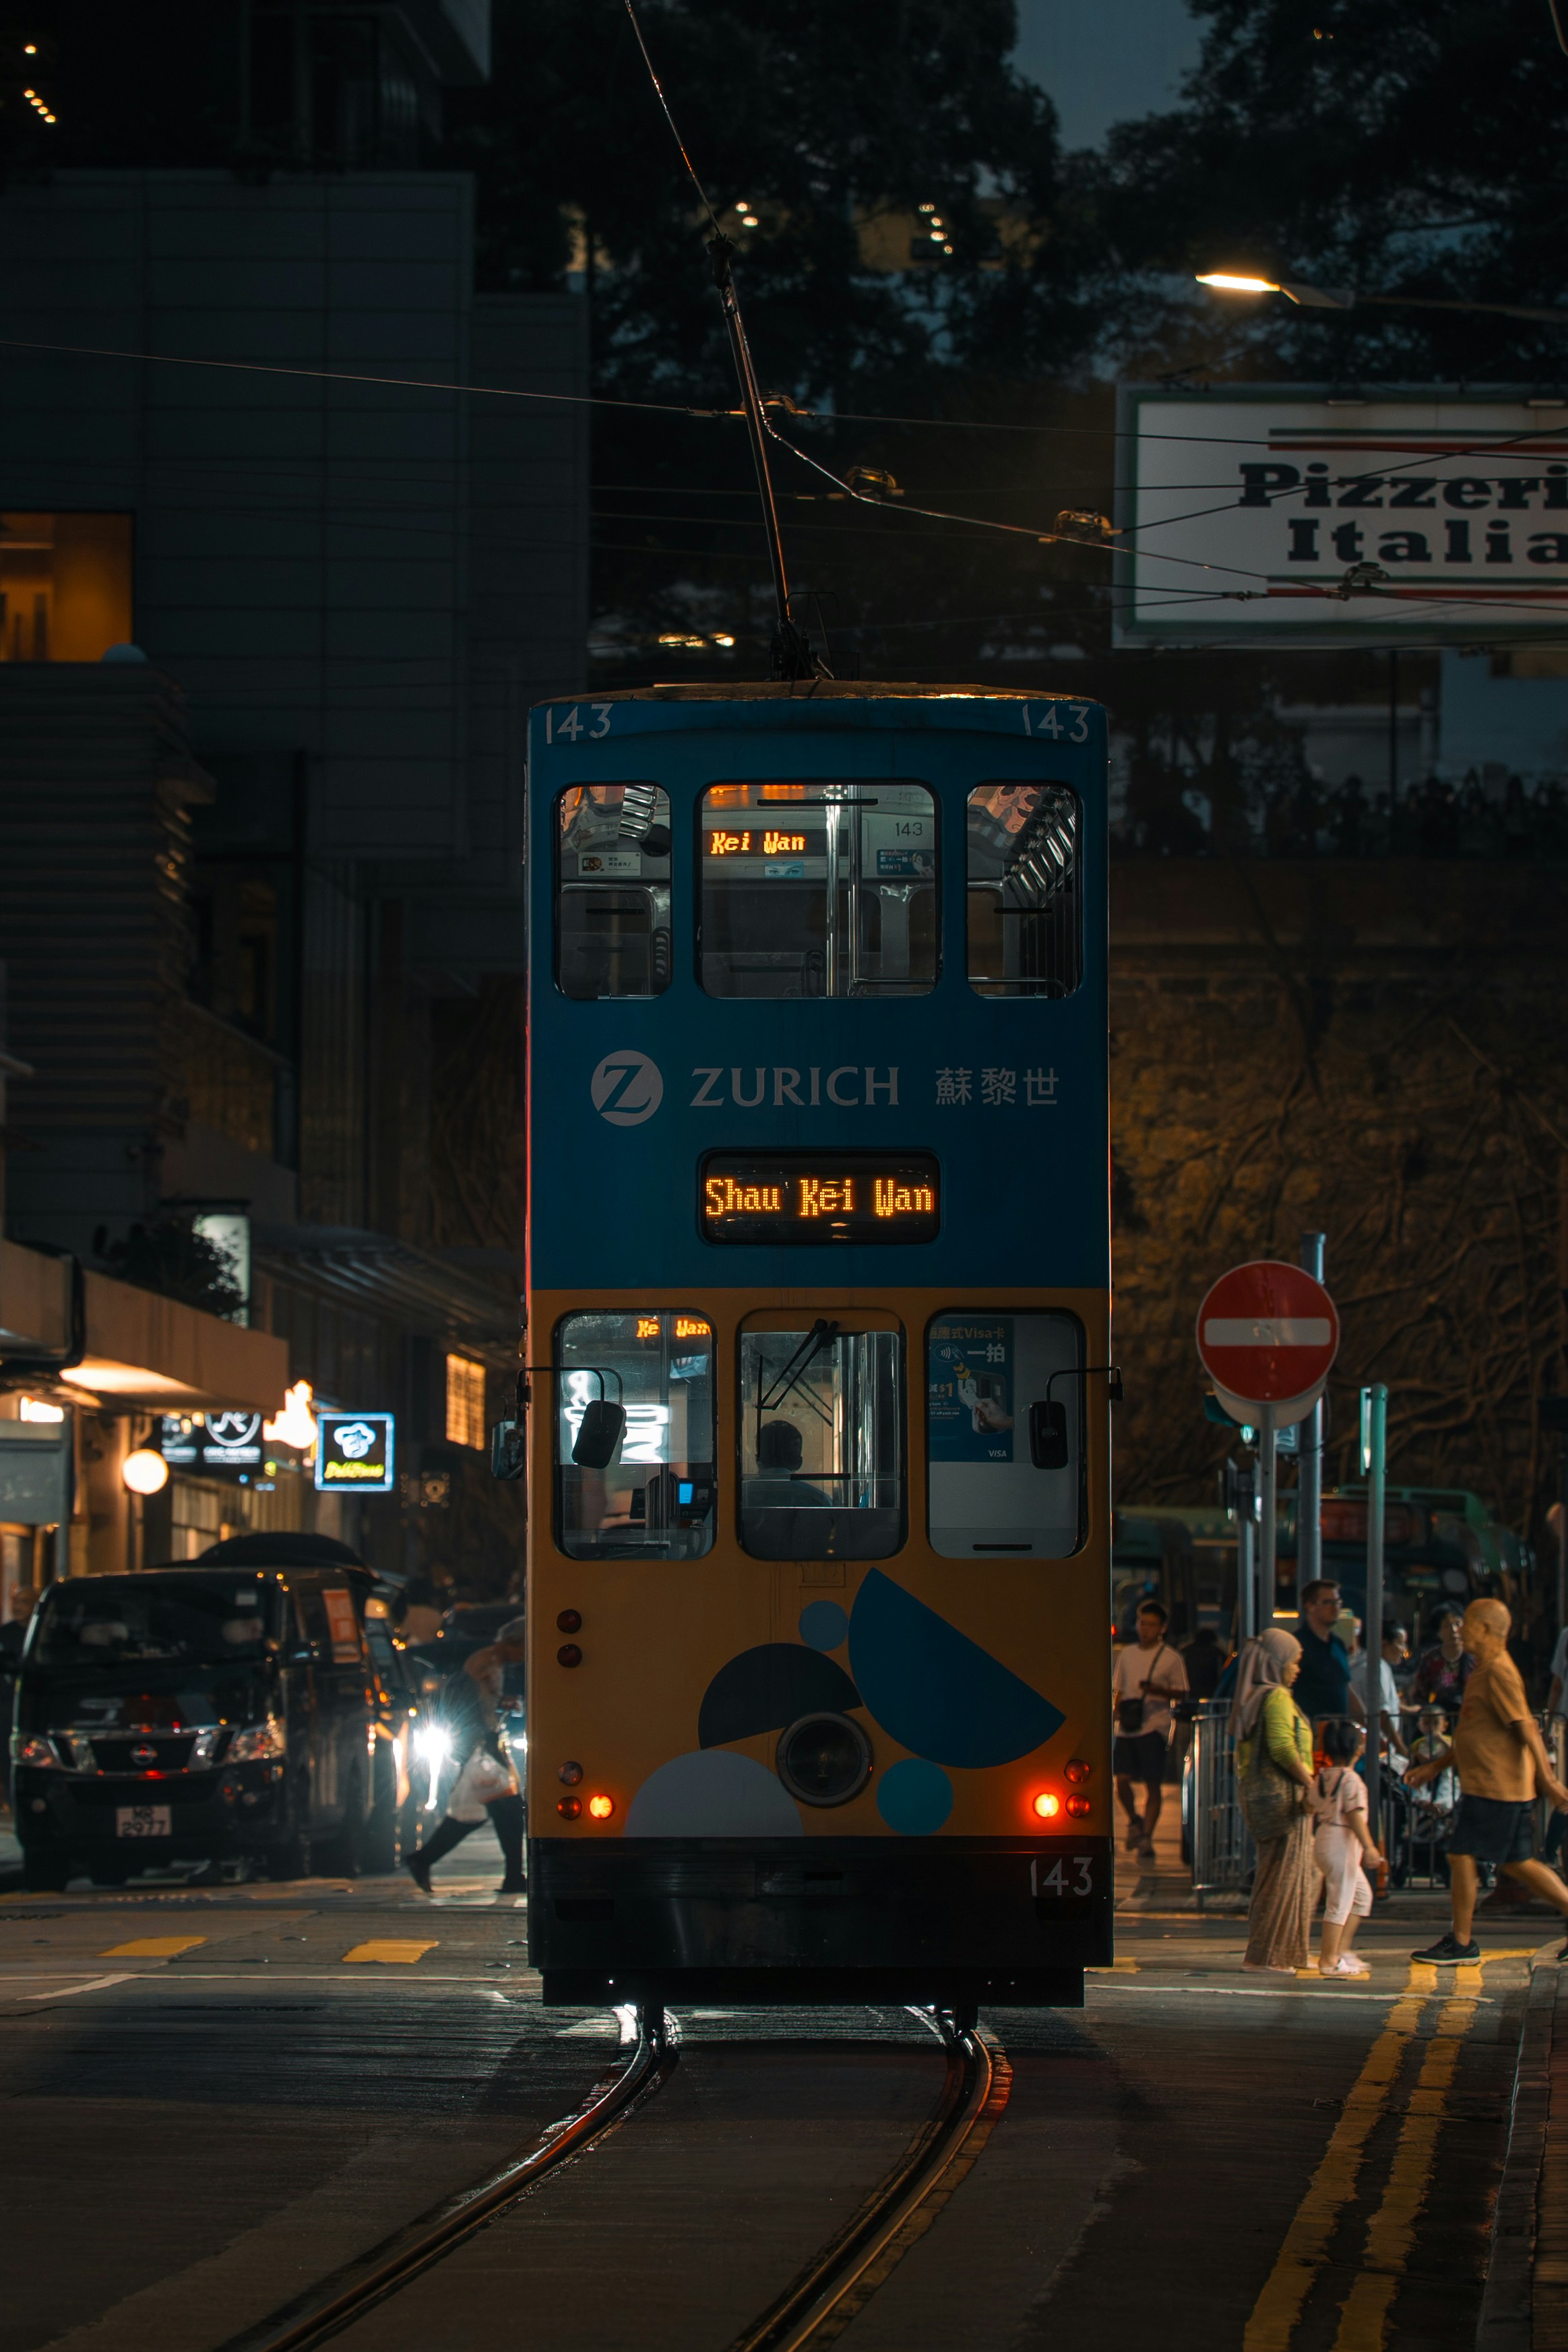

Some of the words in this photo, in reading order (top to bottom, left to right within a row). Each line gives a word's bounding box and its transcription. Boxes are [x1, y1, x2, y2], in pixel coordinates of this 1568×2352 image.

[1238, 462, 1568, 509] Pizzeri
[1287, 518, 1568, 564] Italia
[546, 703, 614, 745] 143
[1022, 703, 1090, 743] 143
[711, 832, 750, 855] Kei
[763, 832, 805, 855] Wan
[895, 822, 922, 836] 143
[689, 1066, 900, 1107] ZURICH
[935, 1067, 1060, 1107] 蘇黎世
[706, 1179, 780, 1215] Shau
[800, 1179, 853, 1216] Kei
[875, 1179, 931, 1216] Wan
[677, 1320, 712, 1338] Wan
[988, 1450, 1007, 1458] VISA
[1030, 1857, 1094, 1897] 143
